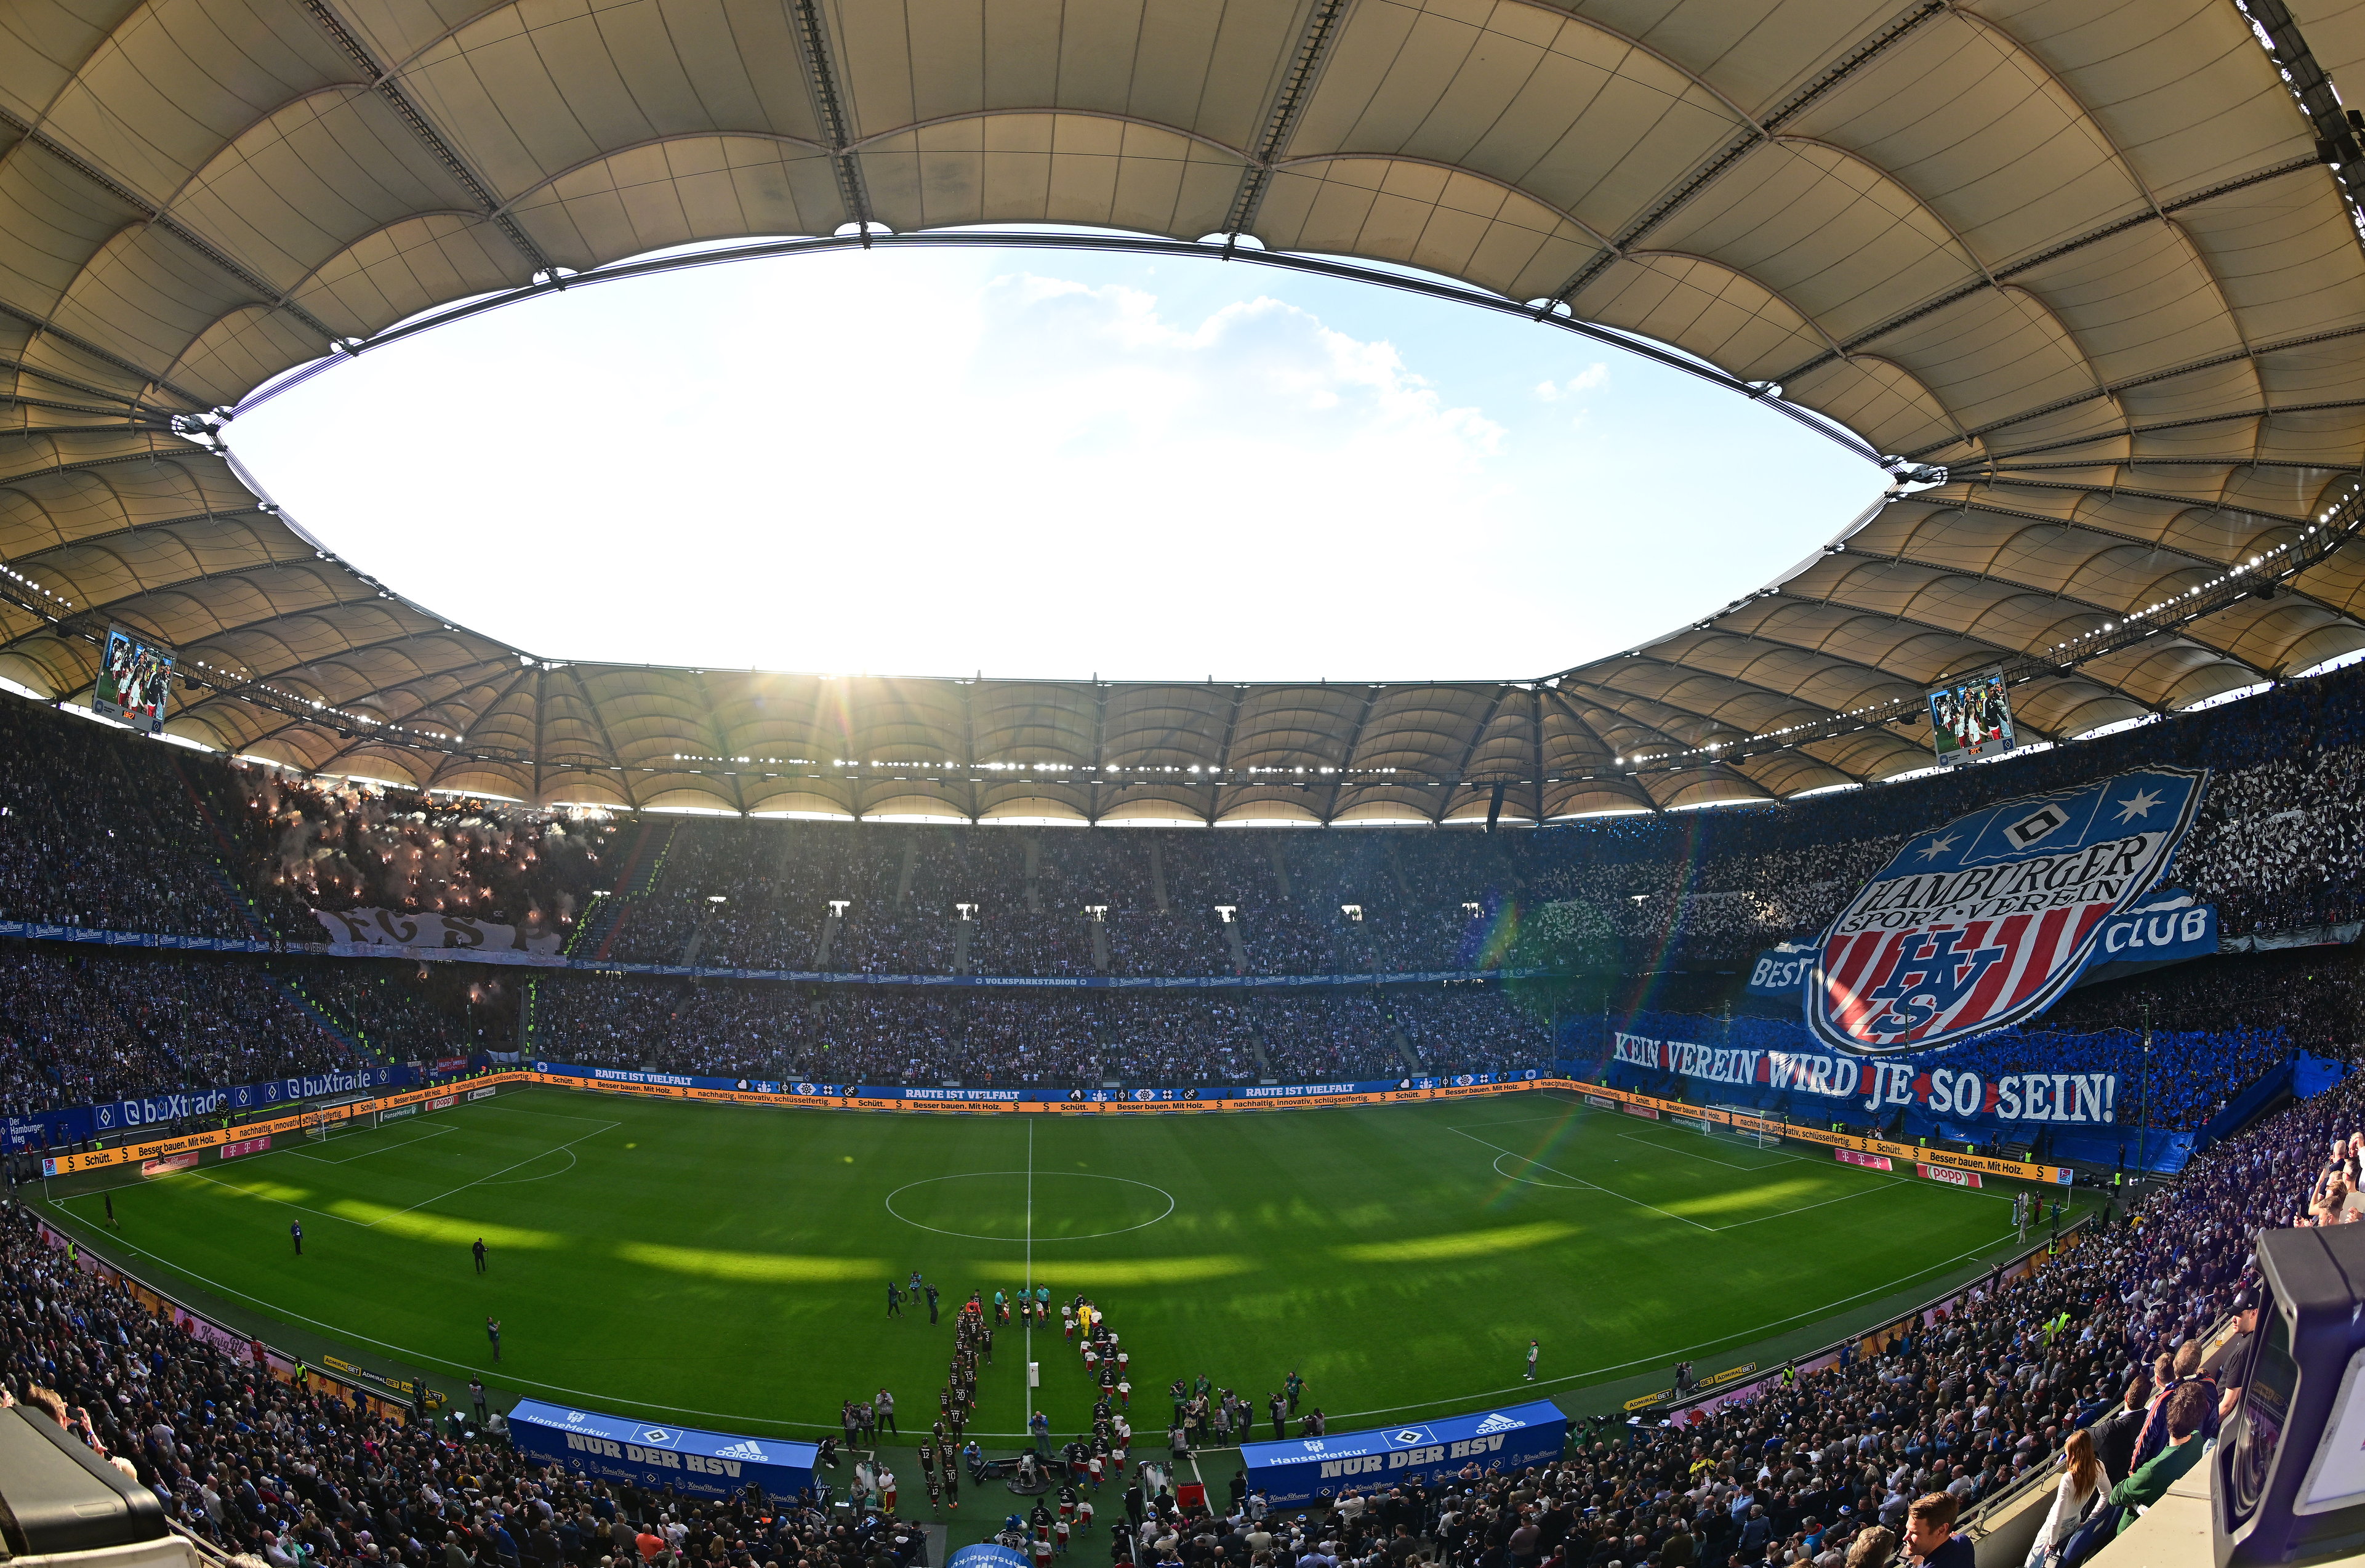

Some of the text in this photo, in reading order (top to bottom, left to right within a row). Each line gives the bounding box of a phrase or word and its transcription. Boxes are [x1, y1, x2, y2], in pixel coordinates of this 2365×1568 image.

[1860, 834, 2149, 917] HAMBURGER
[1751, 909, 2209, 988] BEST CLUB
[304, 1070, 370, 1096] buXtrade
[553, 1077, 574, 1085] Schütt.
[595, 1069, 692, 1085] RAUTE IST VIELFALT
[1614, 1032, 2116, 1122] KEIN VEREIN WIRD JE SO SEIN!
[476, 1088, 495, 1097] Hapag-Lloyd
[620, 1084, 643, 1092] bauen.
[905, 1089, 1019, 1100] RAUTE IST VIELFALT
[1246, 1084, 1354, 1096] RAUTE IST VIELFALT
[394, 1096, 409, 1104] Besser
[410, 1093, 424, 1101] bauen.
[432, 1088, 441, 1096] Holz.
[698, 1091, 830, 1105] nachhaltig, innovativ, schlüsselfertig.
[859, 1099, 885, 1107] Schütt.
[1234, 1100, 1275, 1108] nachhaltig,
[1277, 1098, 1312, 1106] innovativ,
[436, 1098, 451, 1109] popp
[1666, 1103, 1682, 1112] Besser
[1683, 1106, 1698, 1116] bauen.
[384, 1108, 411, 1120] HanseMerkur
[9, 1117, 20, 1126] Der
[239, 1124, 273, 1138] nachhaltig,
[274, 1117, 300, 1130] innovativ
[1672, 1117, 1700, 1128] HanseMerkur
[1740, 1119, 1771, 1132] nachhatig,
[10, 1124, 44, 1135] Hamburger
[12, 1135, 25, 1144] Weg
[1802, 1130, 1851, 1147] schlüsselfertig.
[139, 1135, 216, 1157] Besser bauen. Mit Holz.
[1877, 1143, 1903, 1156] Schütt.
[85, 1153, 112, 1166] Schütt.
[1930, 1152, 1957, 1166] Besser
[1958, 1157, 1985, 1169] bauen.
[1988, 1160, 2001, 1171] Mit
[2002, 1164, 2023, 1175] Holz.
[1933, 1168, 1962, 1183] popp
[325, 1357, 359, 1374] ADMIRAL BET
[1717, 1364, 1754, 1381] ADMIRAL BET
[362, 1370, 386, 1383] ADMIRAL
[387, 1379, 398, 1387] BET
[1701, 1378, 1713, 1386] BET
[1629, 1391, 1671, 1409] ADMIRAL BET
[527, 1415, 611, 1437] HanseMerkur
[1476, 1420, 1526, 1435] adidas
[566, 1433, 742, 1478] NUR DER HSV
[715, 1448, 769, 1462] adidas
[1271, 1448, 1367, 1465] HanseMerkur
[1320, 1433, 1506, 1479] NUR DER HSV
